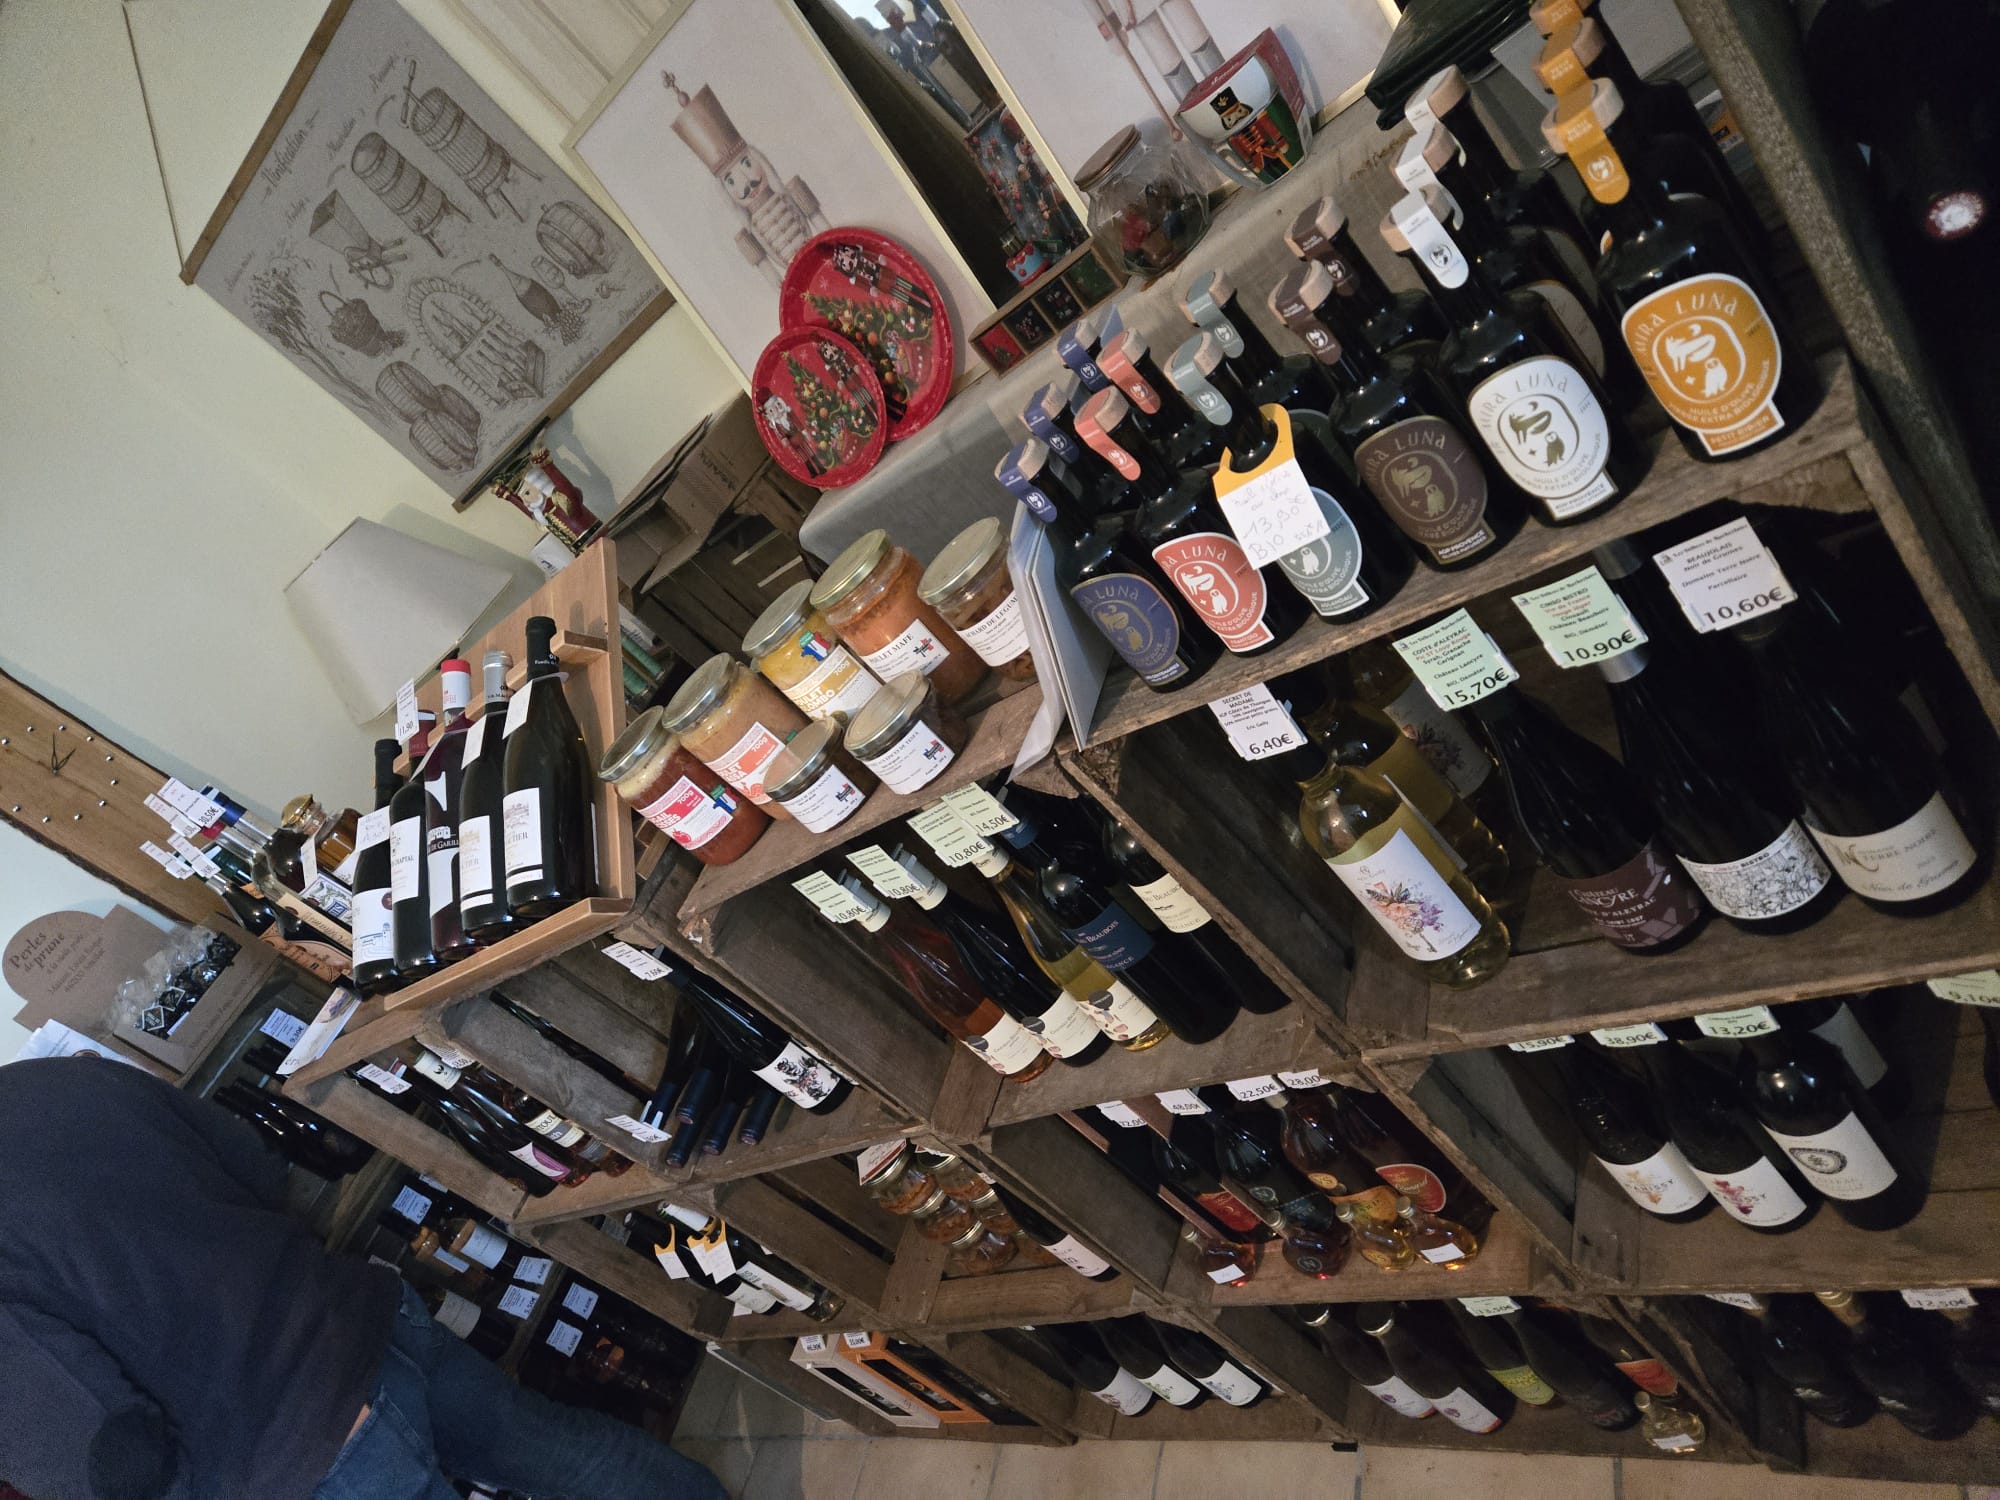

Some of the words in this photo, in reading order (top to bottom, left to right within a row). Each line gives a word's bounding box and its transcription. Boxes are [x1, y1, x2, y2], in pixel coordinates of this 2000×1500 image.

[1236, 591, 1258, 630] BIOLOGIQUE
[1704, 586, 1786, 623] 10,60€
[1413, 645, 1432, 656] COSTE
[1564, 629, 1636, 662] 10.90€
[1444, 667, 1509, 705] 15,70€
[1222, 694, 1242, 705] SECRET
[1229, 697, 1254, 709] MADAME
[1249, 733, 1293, 755] 6,40€
[677, 791, 694, 804] 700g
[975, 814, 1009, 833] 14,50€
[948, 842, 986, 864] 10,80€
[9, 931, 47, 969] Perles
[24, 962, 34, 973] de
[33, 932, 66, 969] prune
[1708, 1020, 1770, 1036] 13,20€
[1606, 1031, 1658, 1046] 38,90€
[1240, 1083, 1278, 1099] 22,50€
